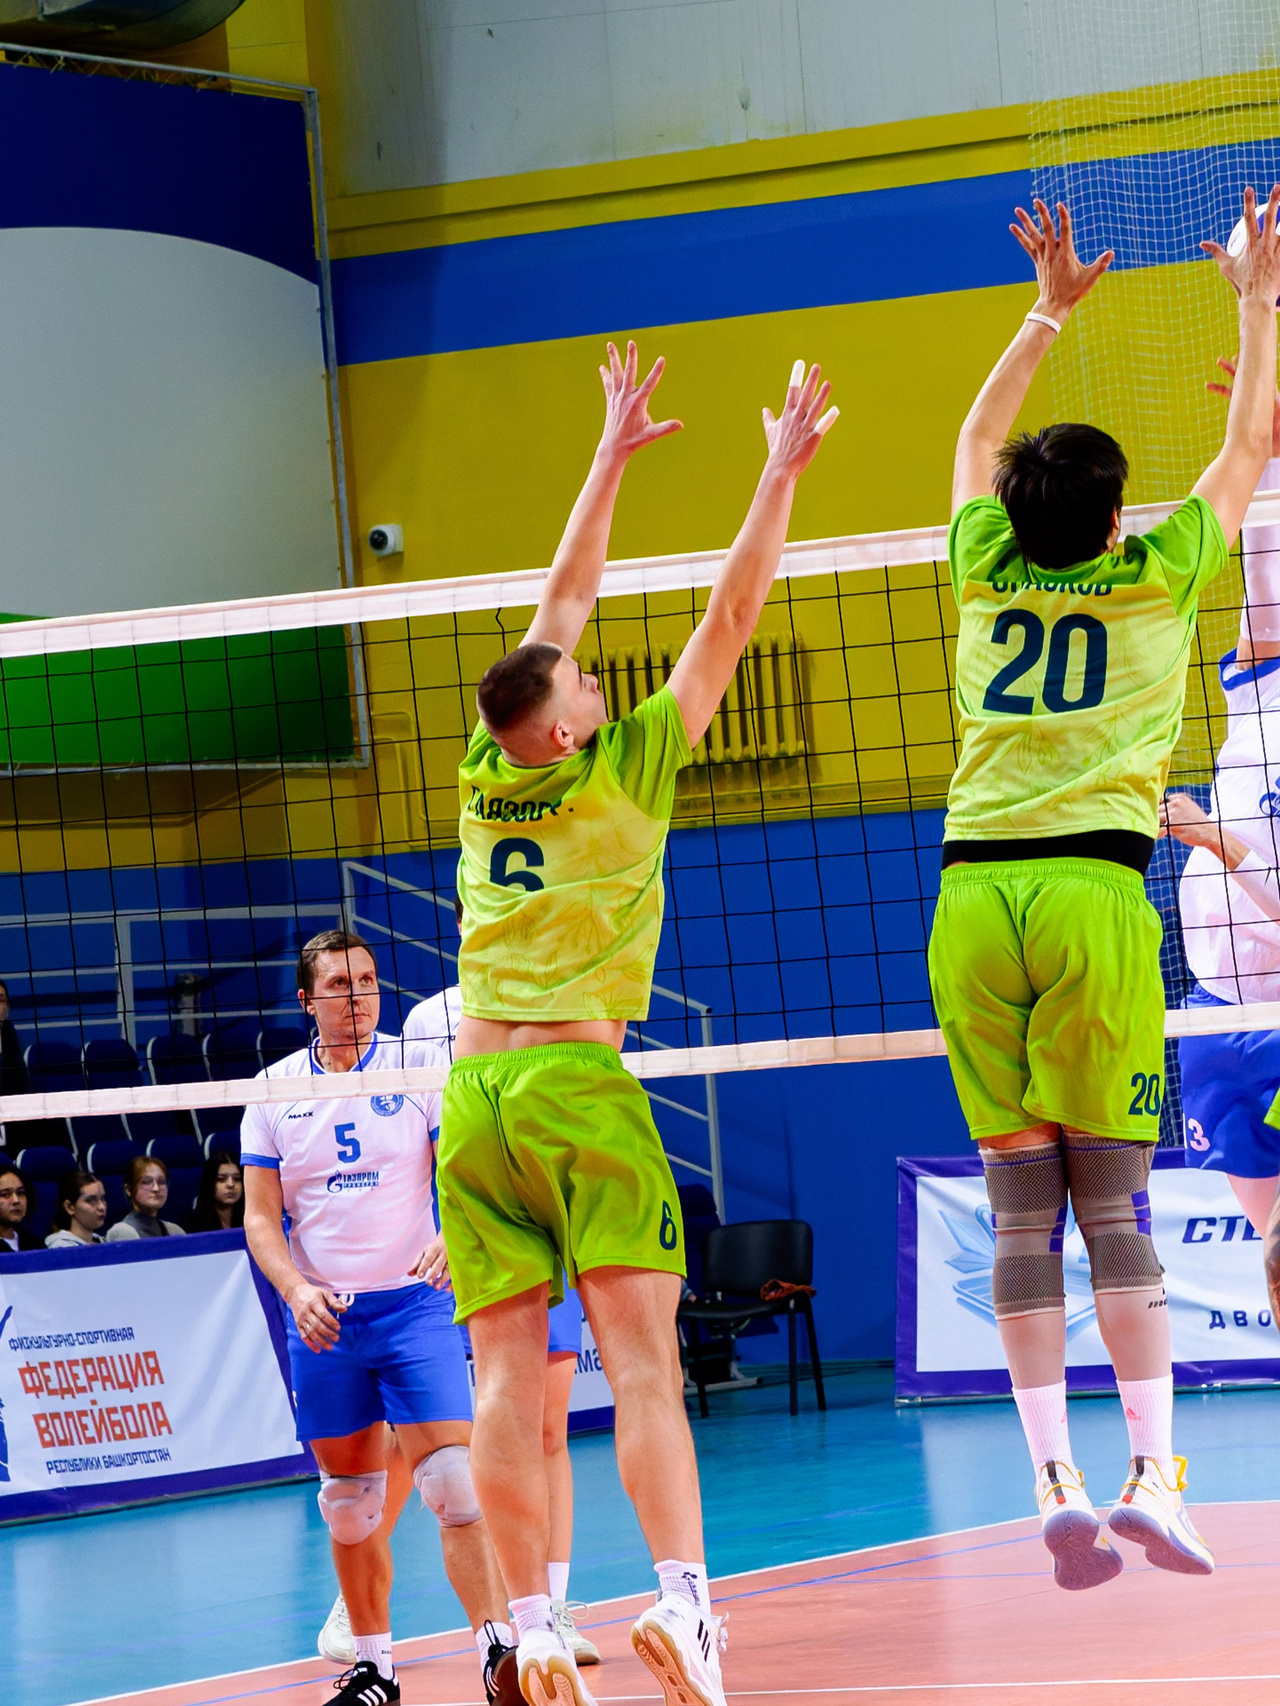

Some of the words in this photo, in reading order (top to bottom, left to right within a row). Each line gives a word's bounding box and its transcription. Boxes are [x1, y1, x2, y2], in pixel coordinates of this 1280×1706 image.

[983, 608, 1107, 715] 20
[489, 837, 545, 892] 6
[1128, 1073, 1160, 1115] 20
[334, 1122, 361, 1163] 5
[1183, 1112, 1211, 1152] 3
[659, 1200, 677, 1250] 6
[9, 1326, 135, 1352] ФИЗКУЛЬТУРНО-СПОРТИВНАЯ
[18, 1350, 165, 1400] ФЕДЕРАЦИЯ
[32, 1399, 173, 1449] ВОЛЕЙБОЛА
[46, 1455, 102, 1475] РЕСПУБЛИКИ
[103, 1447, 172, 1470] БАШКОРТОСТАН
